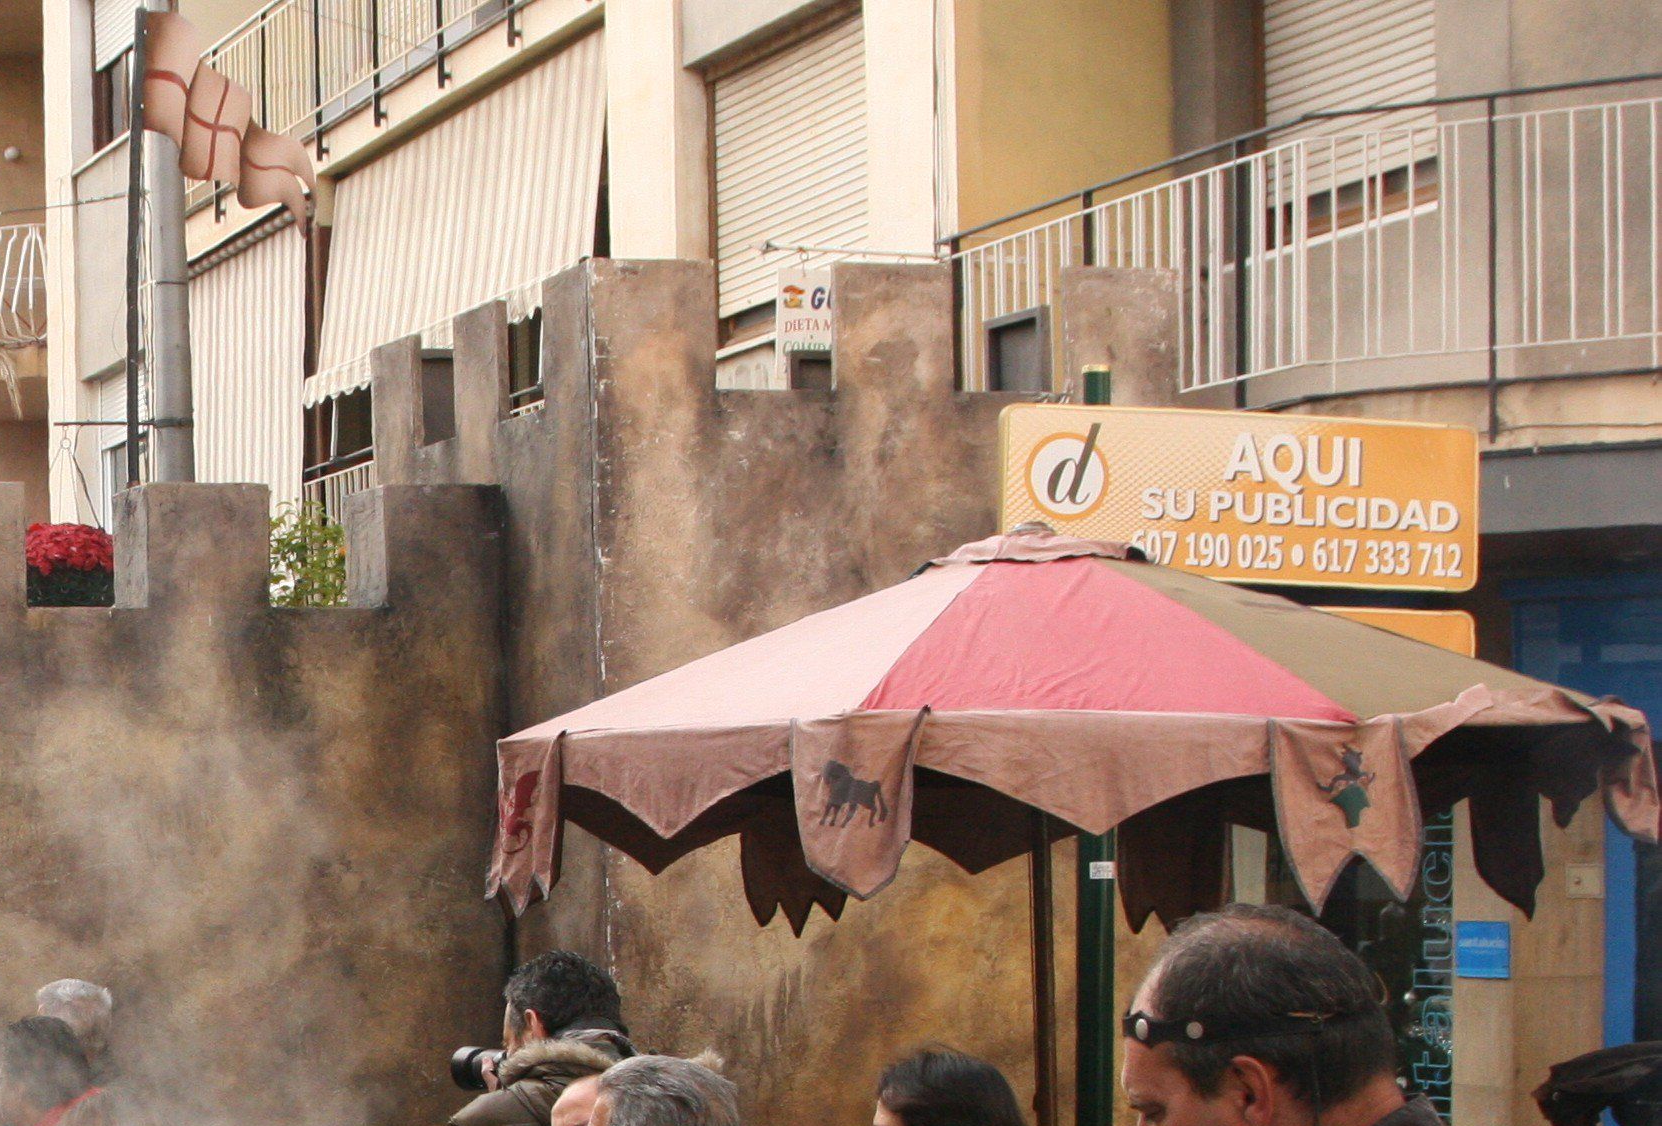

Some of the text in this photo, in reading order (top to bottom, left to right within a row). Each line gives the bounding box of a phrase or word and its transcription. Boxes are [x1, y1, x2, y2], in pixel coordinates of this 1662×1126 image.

[1223, 432, 1364, 493] AQUI
[1140, 486, 1460, 533] SU PUBLICIDAD
[1186, 531, 1231, 569] 190
[1237, 533, 1283, 571] 025
[1312, 537, 1359, 574] 617
[1365, 540, 1411, 576] 333
[1417, 542, 1463, 578] 712
